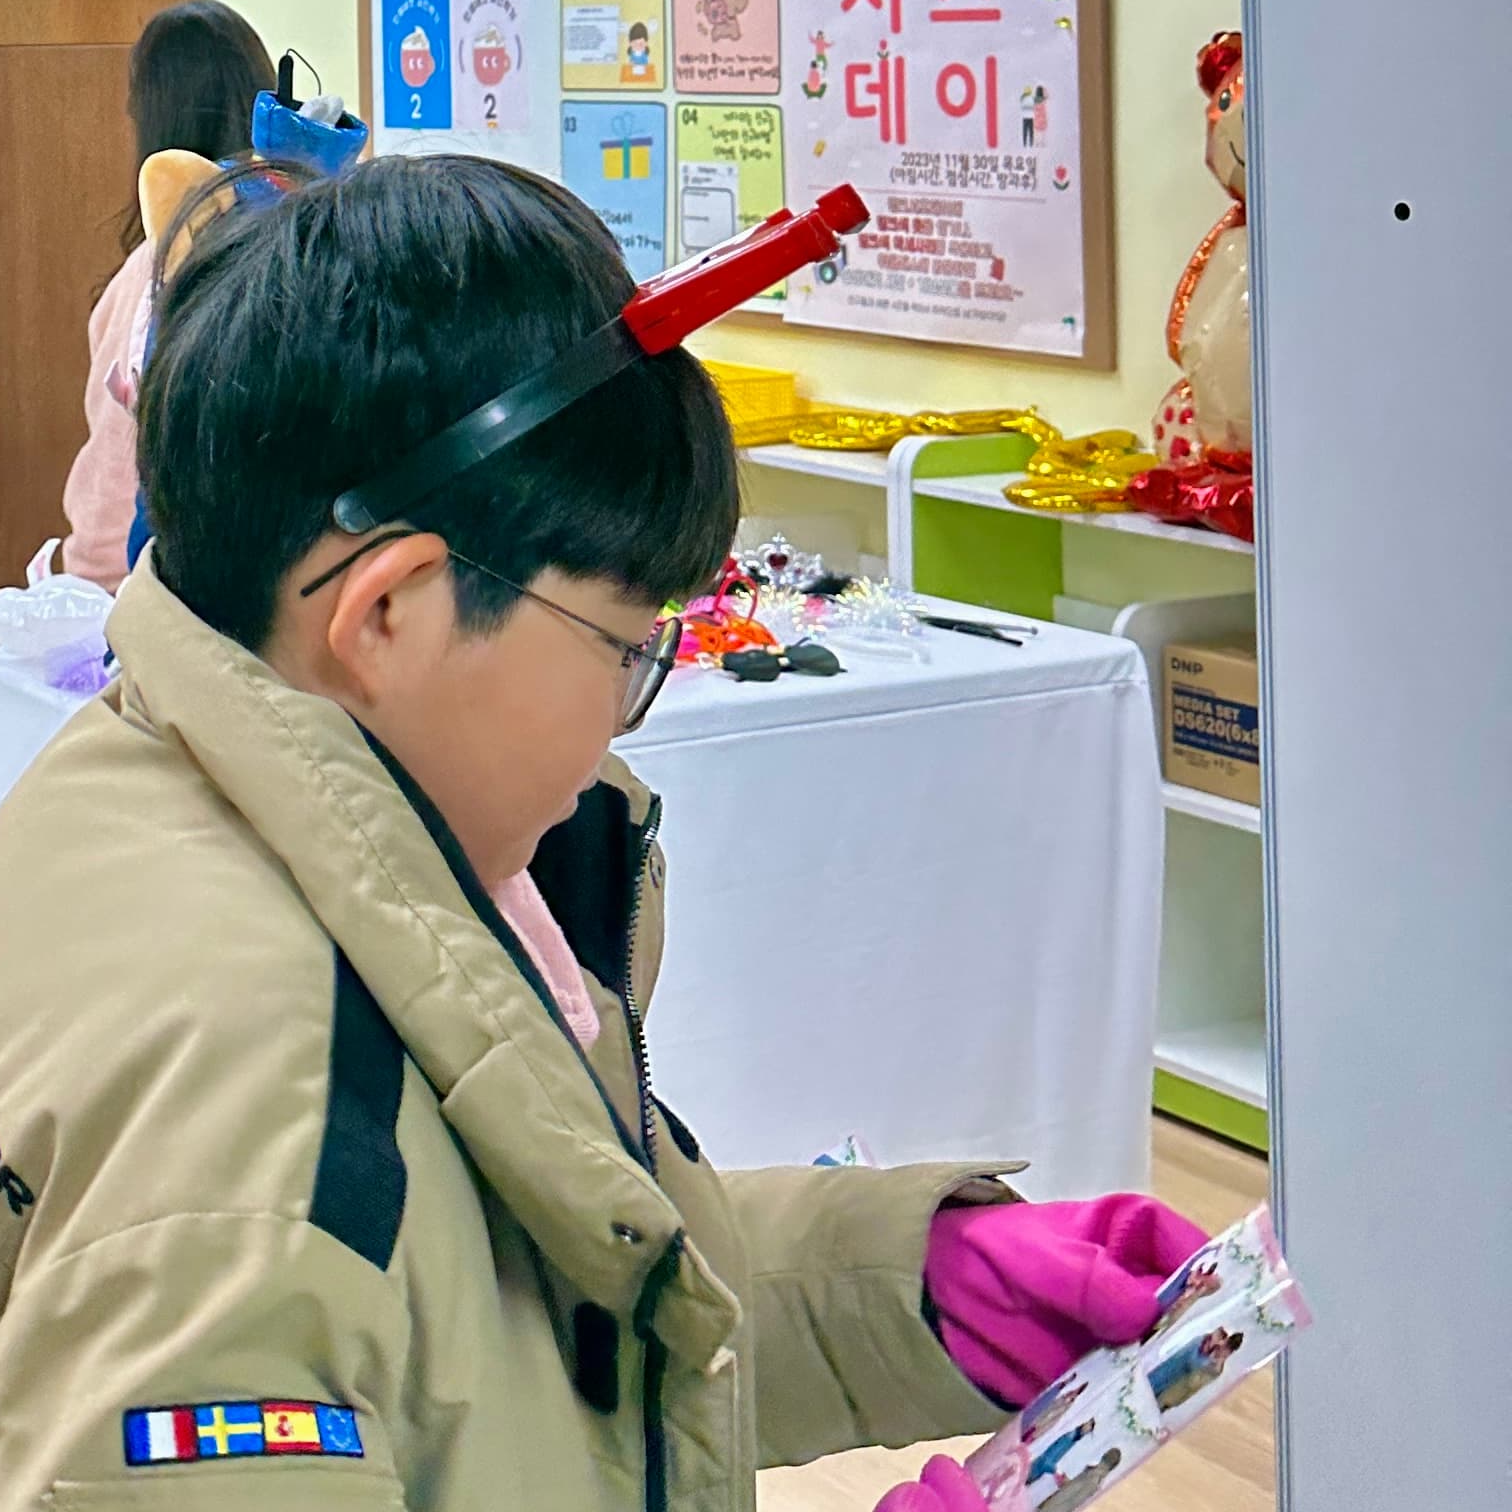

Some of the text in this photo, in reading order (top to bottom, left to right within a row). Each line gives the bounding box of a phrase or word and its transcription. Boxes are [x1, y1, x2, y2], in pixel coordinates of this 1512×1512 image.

[409, 93, 422, 119] 2
[483, 93, 497, 119] 2
[844, 55, 998, 148] 데이
[682, 108, 698, 125] 04
[1170, 656, 1203, 676] DNP
